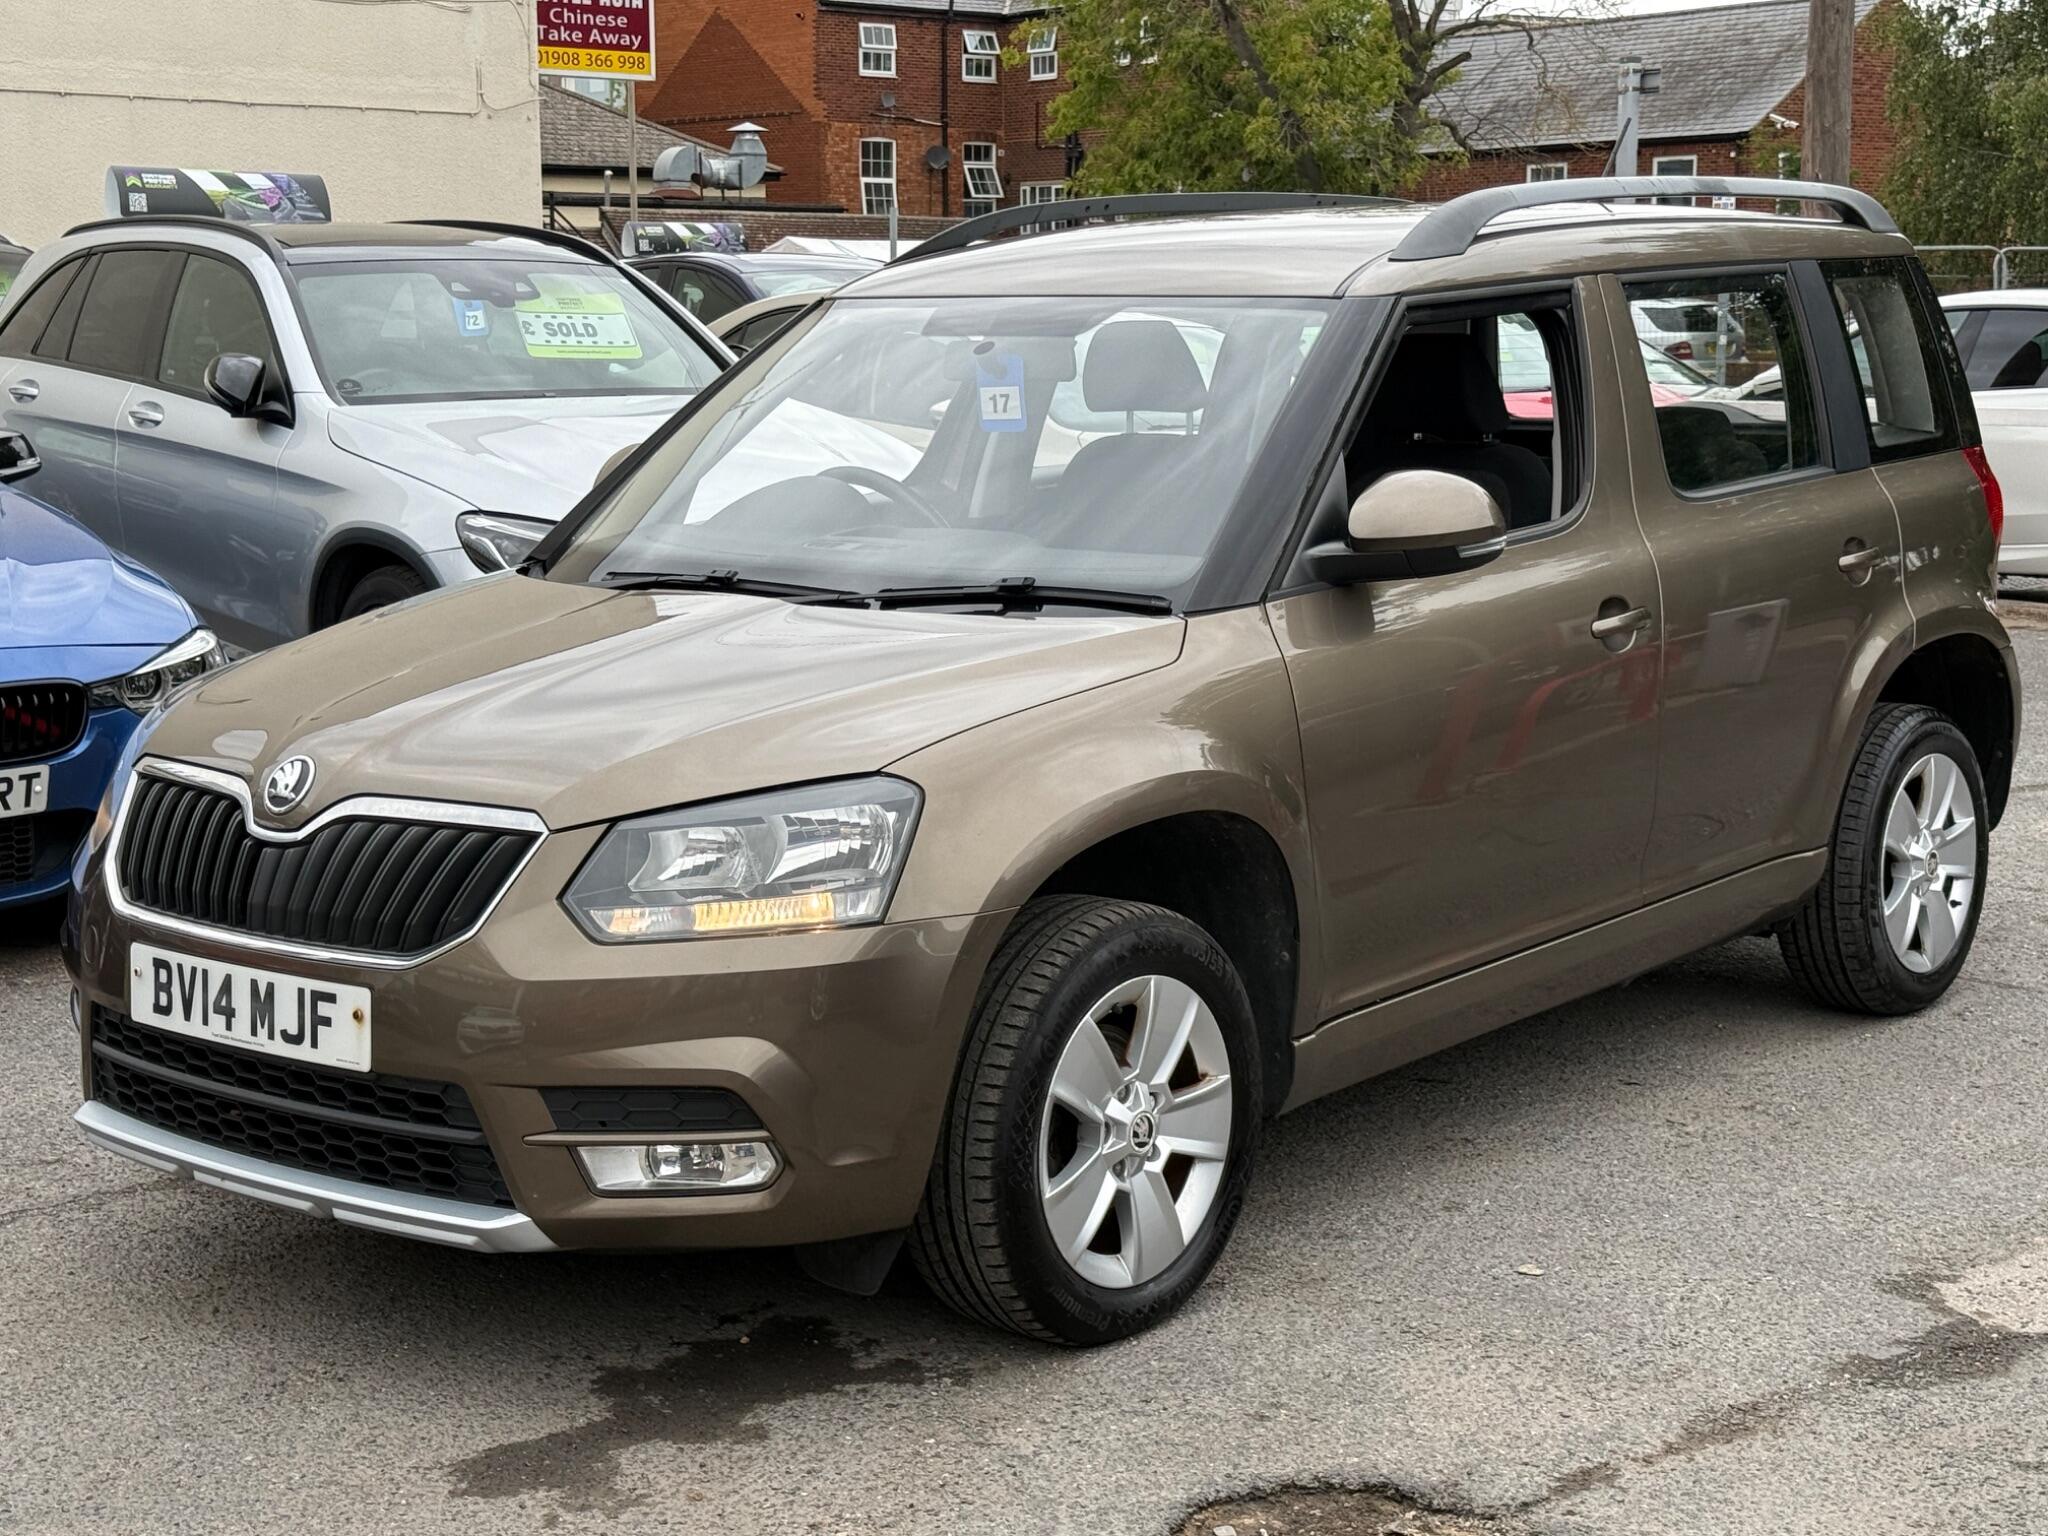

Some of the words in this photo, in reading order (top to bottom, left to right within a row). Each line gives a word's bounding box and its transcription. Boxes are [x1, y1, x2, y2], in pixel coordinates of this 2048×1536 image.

[549, 8, 628, 27] Chinese
[537, 24, 583, 43] Take
[589, 29, 642, 50] Away
[585, 53, 613, 68] 366
[618, 55, 645, 70] 998
[543, 322, 599, 338] SOLD
[988, 393, 1010, 414] 17
[0, 771, 42, 811] RT
[152, 957, 236, 1032] BV14
[250, 978, 337, 1050] MJF
